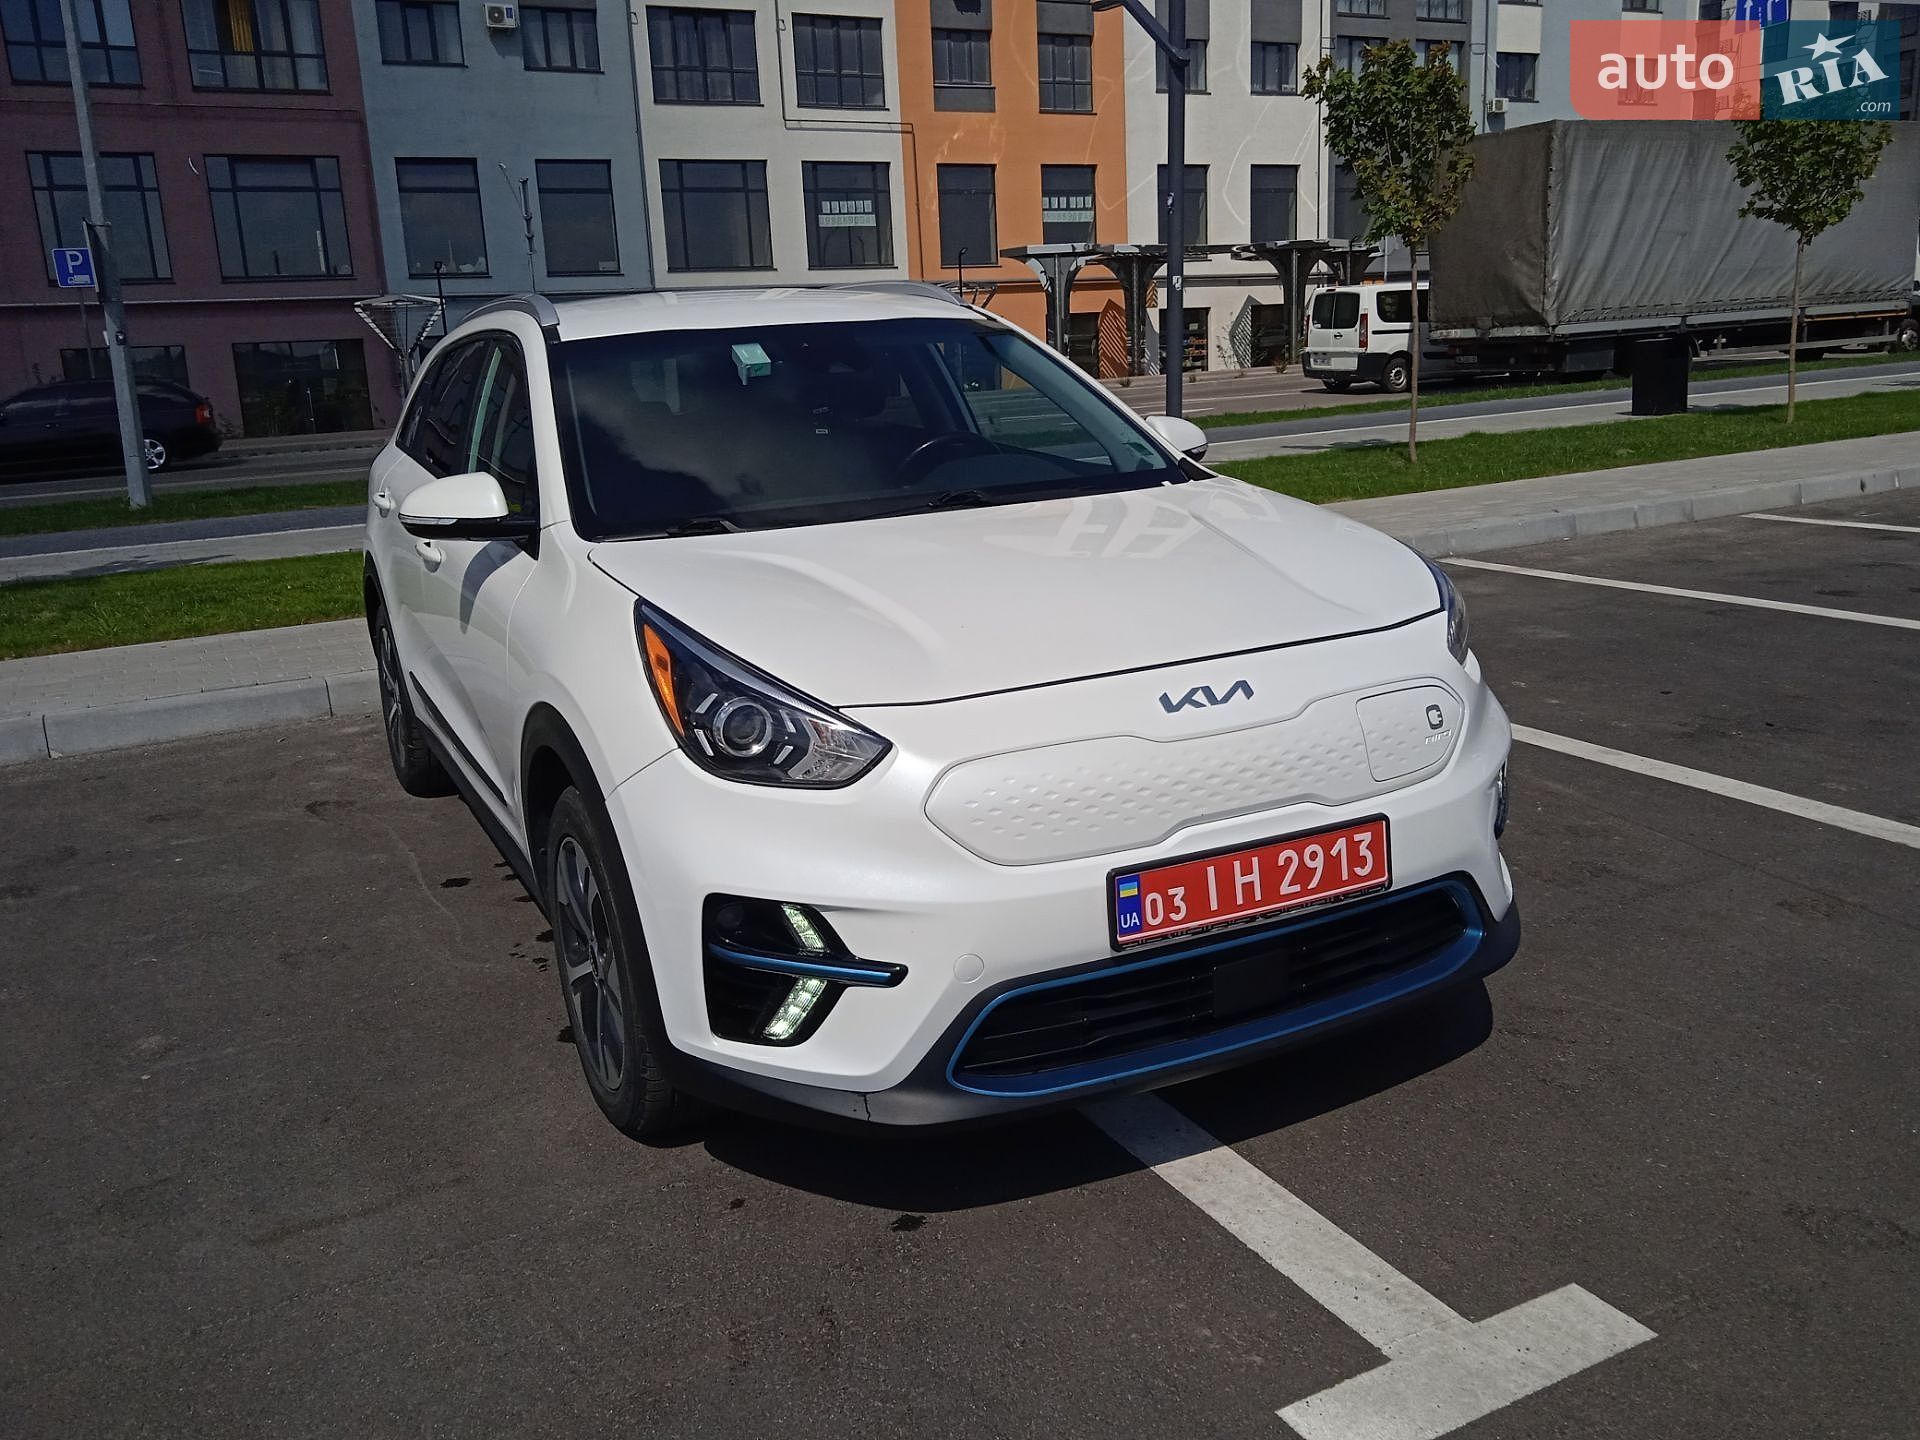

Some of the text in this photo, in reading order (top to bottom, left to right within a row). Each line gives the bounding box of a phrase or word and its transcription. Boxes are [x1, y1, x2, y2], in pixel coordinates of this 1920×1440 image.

[65, 251, 83, 274] P
[1159, 680, 1255, 713] KIA
[1145, 886, 1187, 926] 03
[1277, 832, 1373, 895] 2913
[1121, 912, 1140, 928] UA
